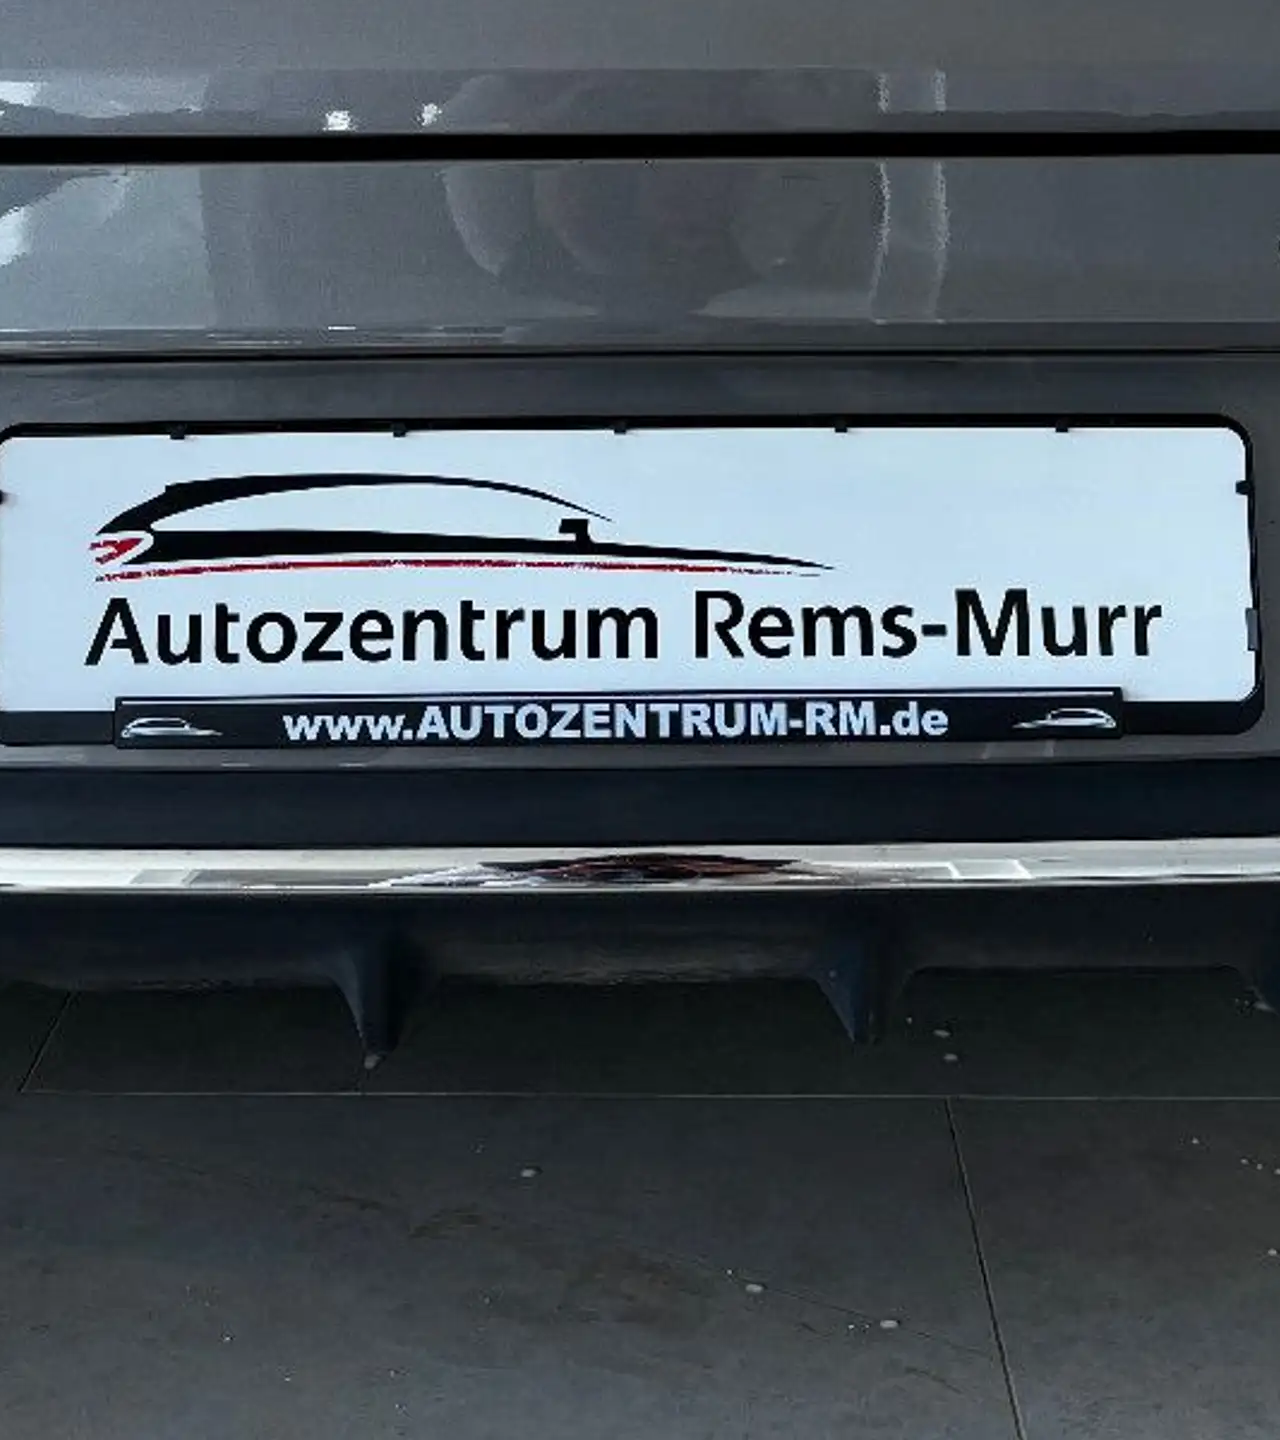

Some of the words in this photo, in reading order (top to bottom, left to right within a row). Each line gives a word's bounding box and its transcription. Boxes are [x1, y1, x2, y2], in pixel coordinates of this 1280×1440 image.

[84, 597, 658, 666] Autozentrum
[695, 588, 1162, 659] Rems-Murr
[282, 701, 949, 741] www.AUTOZENTRUM-RM.de
